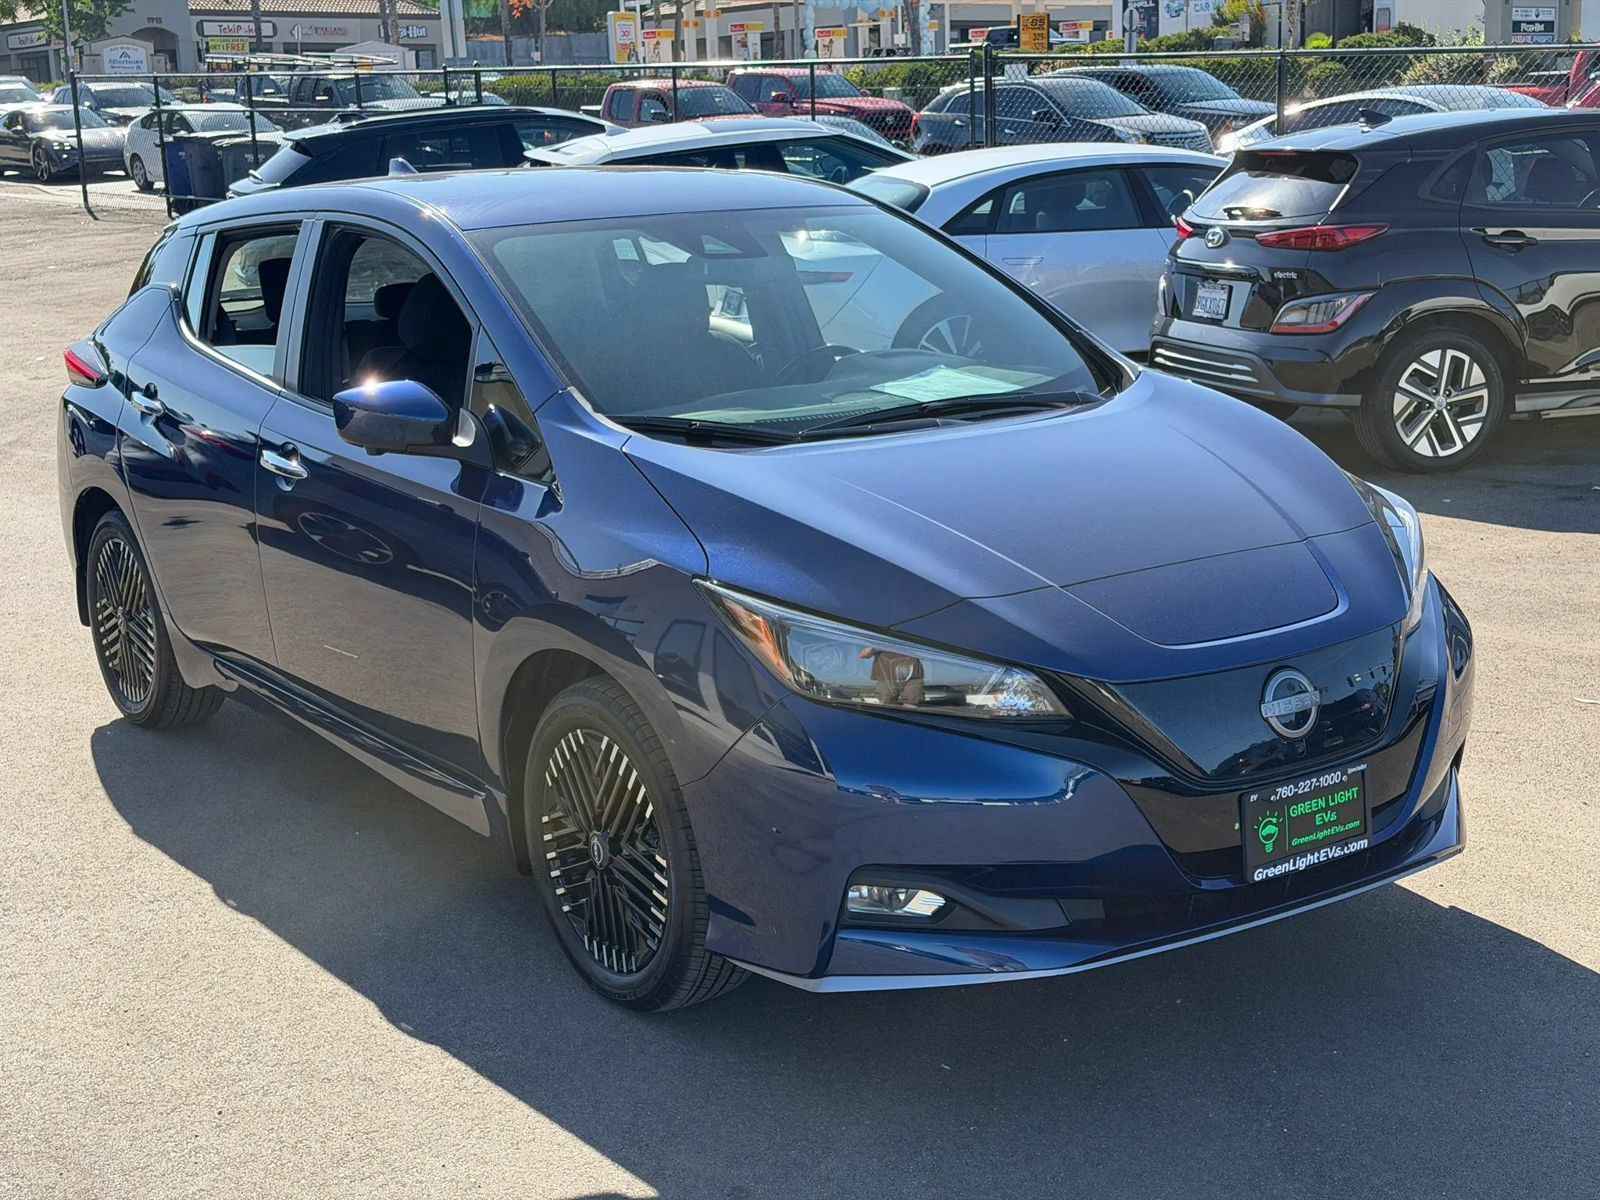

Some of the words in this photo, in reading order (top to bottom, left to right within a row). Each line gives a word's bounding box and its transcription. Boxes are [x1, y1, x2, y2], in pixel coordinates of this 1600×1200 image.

[226, 43, 247, 51] FREE
[1273, 271, 1298, 279] electric
[1264, 692, 1320, 717] NISSAN
[1250, 793, 1259, 802] EV
[1276, 771, 1342, 800] 760-227-1000
[1346, 763, 1368, 775] Specialist
[1289, 798, 1326, 817] GREEN
[1329, 787, 1359, 806] LIGHT
[1315, 810, 1337, 825] EVs
[1291, 820, 1360, 846] GreenLightEVs.com
[1253, 838, 1368, 881] GreenLightEVs.com
